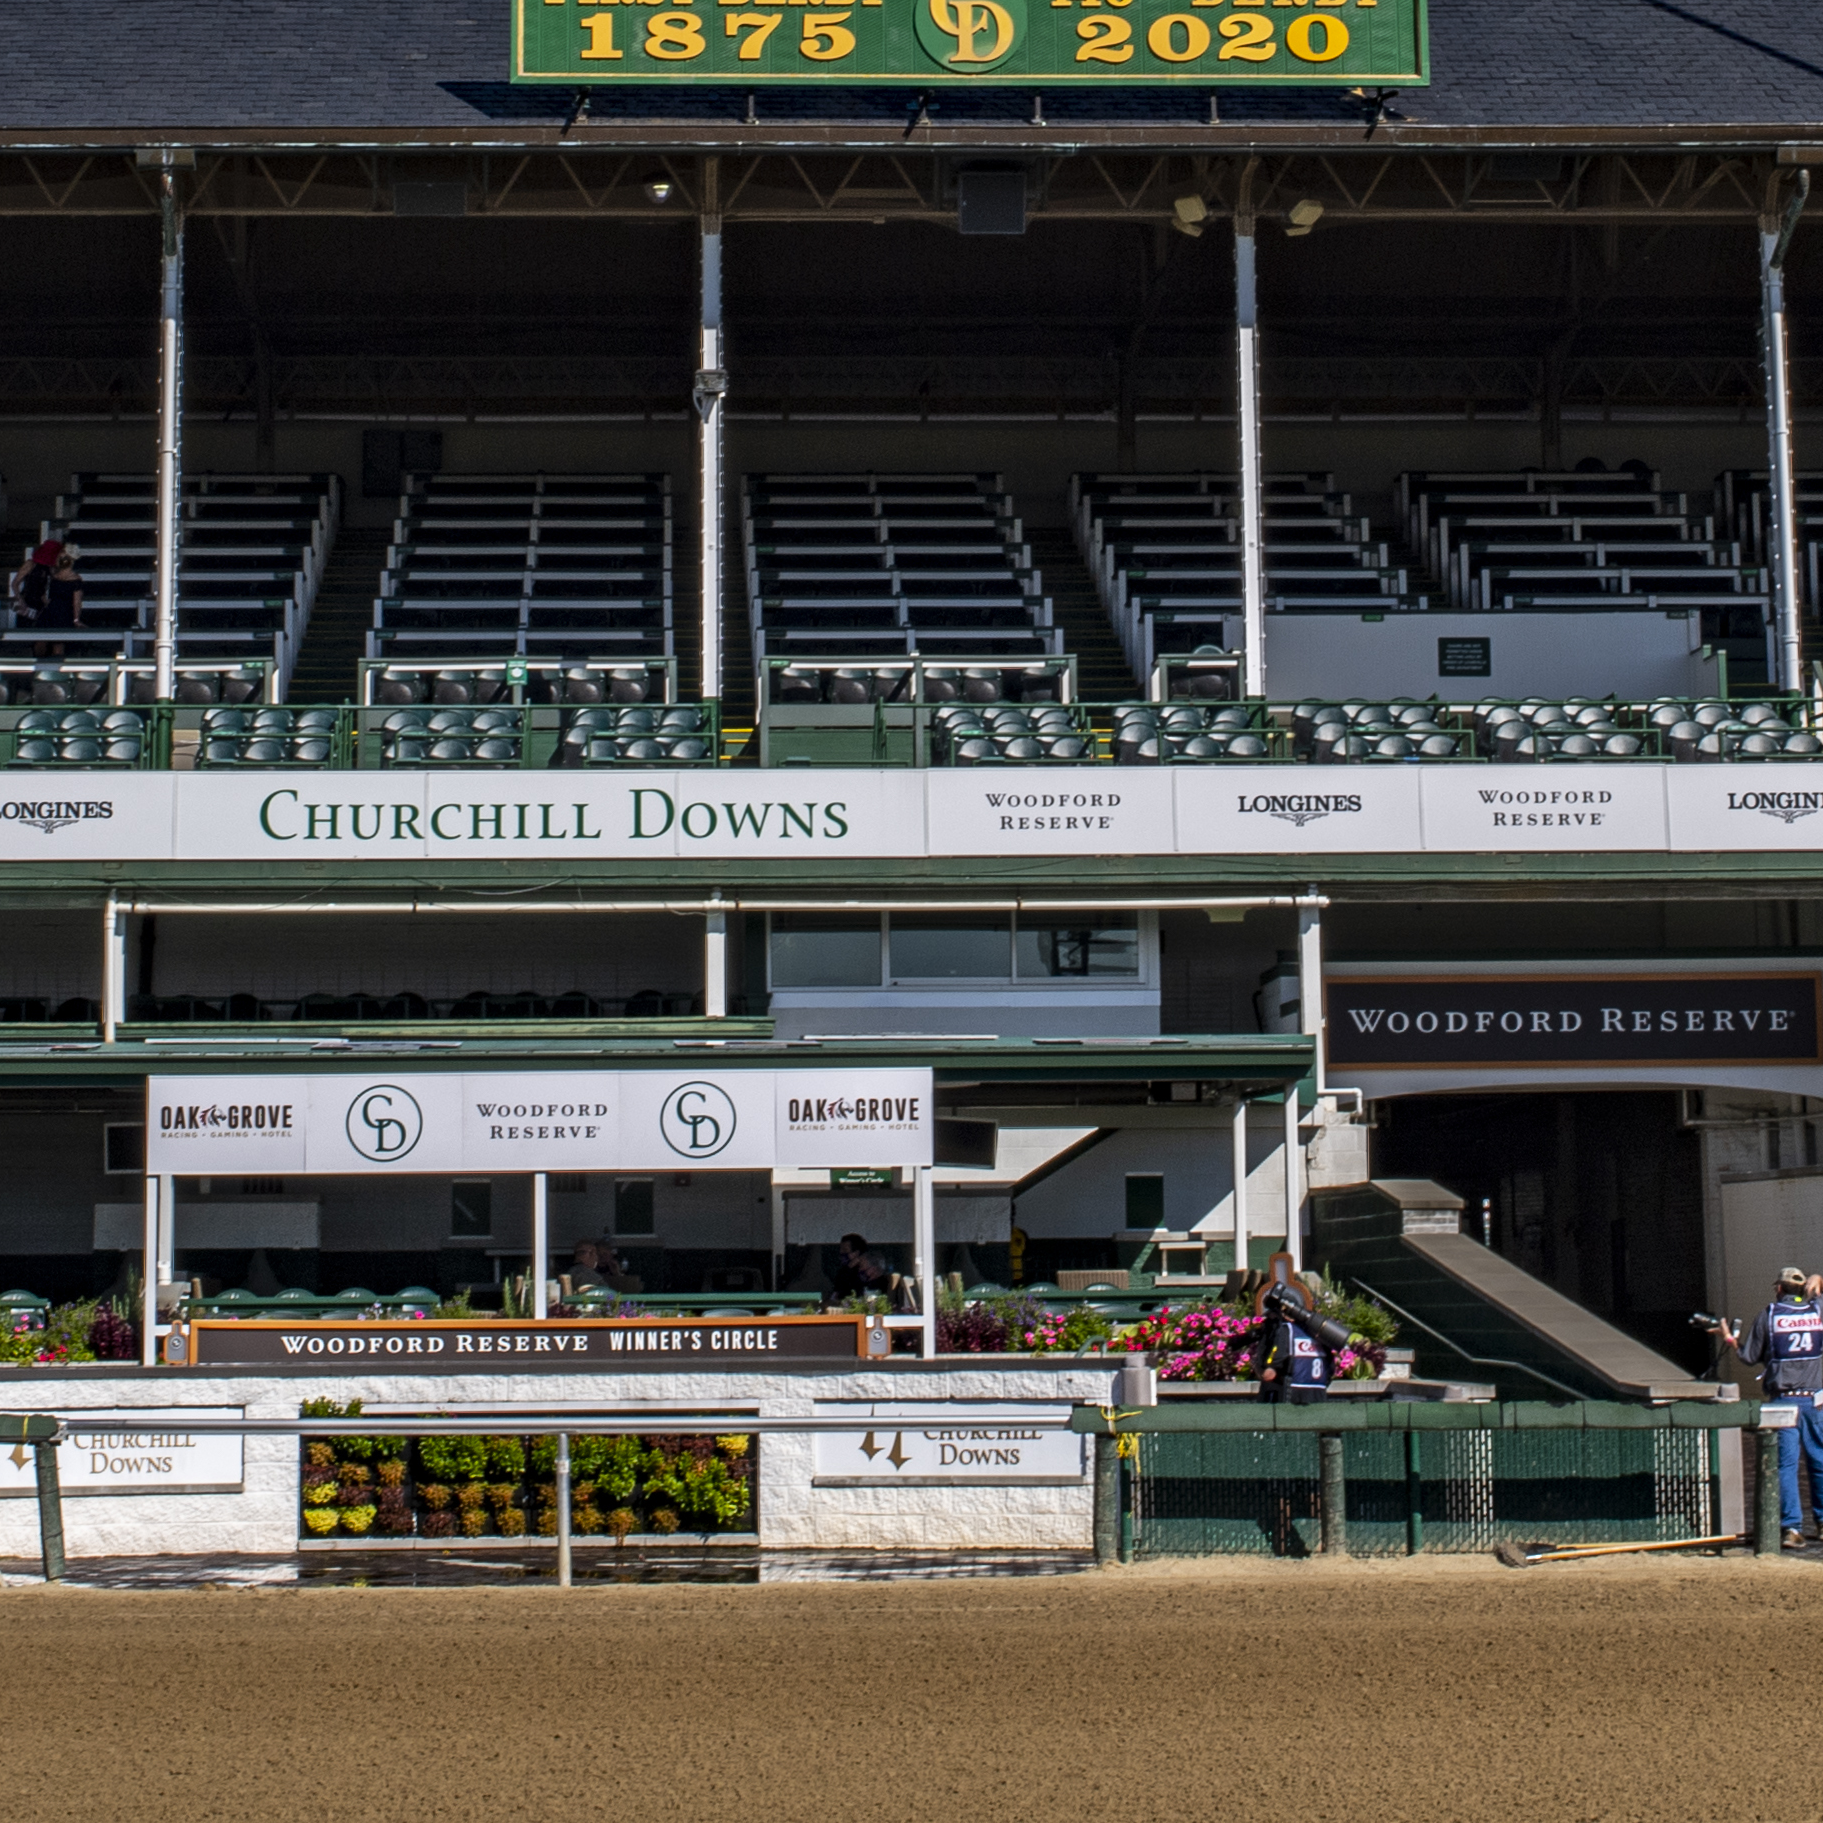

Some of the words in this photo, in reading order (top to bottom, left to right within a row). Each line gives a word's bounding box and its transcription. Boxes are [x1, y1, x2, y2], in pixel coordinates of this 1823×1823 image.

[581, 12, 857, 61] 1875
[1076, 13, 1350, 63] 2020
[985, 793, 1121, 808] WOODFORD
[1238, 794, 1362, 813] LONGINES
[1478, 789, 1612, 804] WOODFORD
[259, 789, 602, 841] CHURCHILL
[628, 789, 849, 841] DOWNS
[1000, 815, 1110, 830] RESERVE
[1493, 811, 1602, 827] RESERVE
[1347, 1009, 1582, 1034] WOODFORD
[1600, 1008, 1789, 1032] RESERVE
[161, 1106, 200, 1130] OAK
[228, 1105, 293, 1129] GROVE
[476, 1103, 608, 1118] WOODFORD
[789, 1099, 827, 1123] OAK
[855, 1098, 920, 1122] GROVE
[261, 1130, 293, 1138] HOTEL
[490, 1125, 597, 1140] RESERVE
[280, 1335, 445, 1354] WOODFORD
[455, 1334, 588, 1353] RESERVE
[609, 1329, 702, 1351] WINNER'S
[711, 1329, 778, 1350] CIRCLE
[1788, 1332, 1814, 1352] 24
[1311, 1358, 1323, 1379] 8
[89, 1452, 173, 1475] DOWNS
[939, 1443, 1021, 1466] DOWNS
